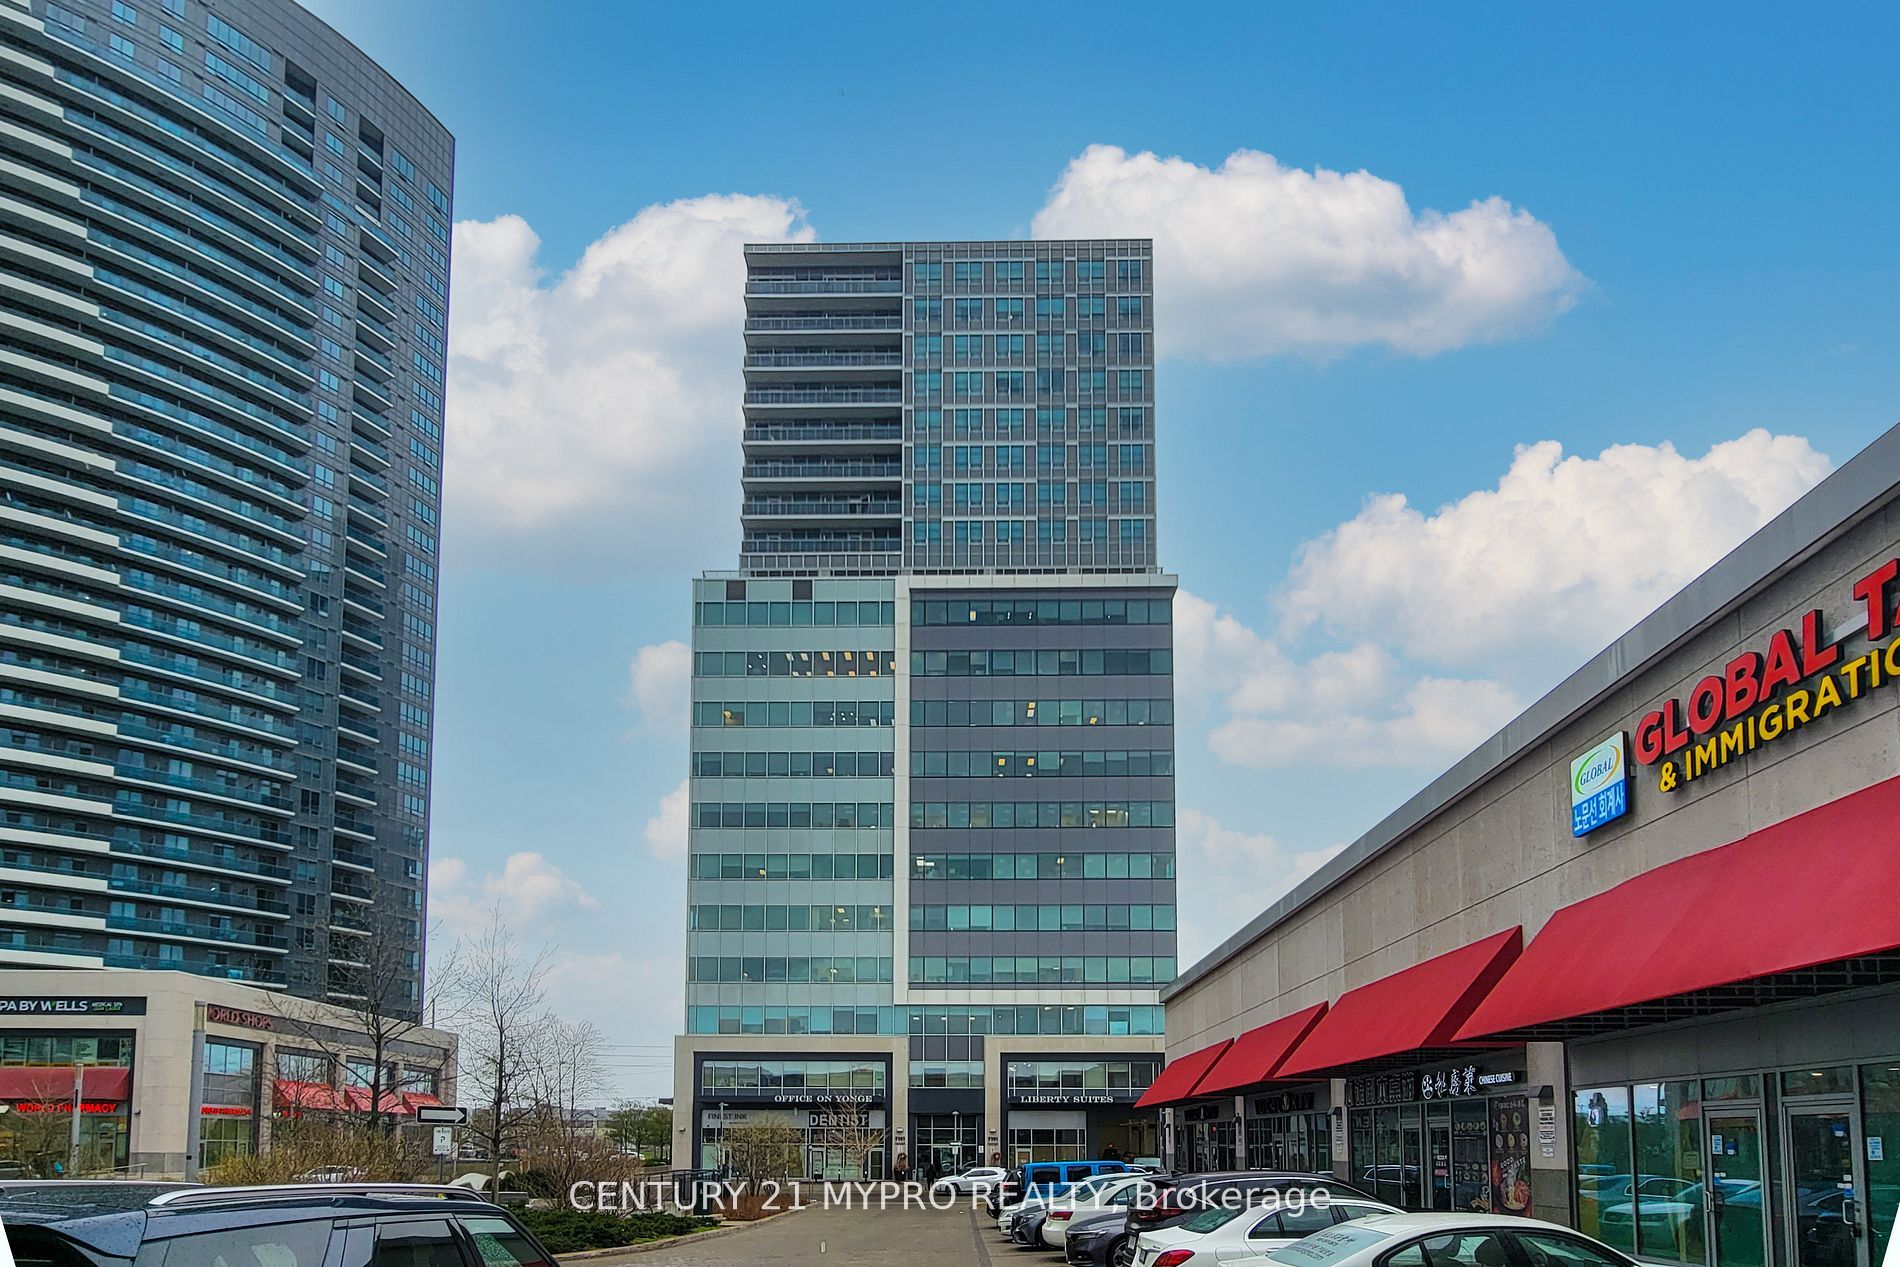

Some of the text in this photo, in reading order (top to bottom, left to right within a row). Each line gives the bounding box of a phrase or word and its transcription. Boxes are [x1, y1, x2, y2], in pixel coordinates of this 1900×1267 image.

[1633, 558, 1900, 766] GLOBAL T
[1580, 757, 1614, 786] GLOBAL
[1659, 761, 1678, 793] &
[1574, 781, 1625, 832] 노문선 회계사
[19, 1000, 38, 1011] BY
[40, 1000, 88, 1011] WELLS
[241, 1013, 273, 1029] SHOPS
[1478, 1072, 1513, 1085] CHINESE CUISINE
[774, 1094, 873, 1103] OFFICE ON YONGE
[1020, 1095, 1114, 1104] LIBERTY SUITES
[57, 1103, 117, 1113] PHRMACY
[734, 1112, 748, 1120] INK
[809, 1113, 868, 1127] DENTIST
